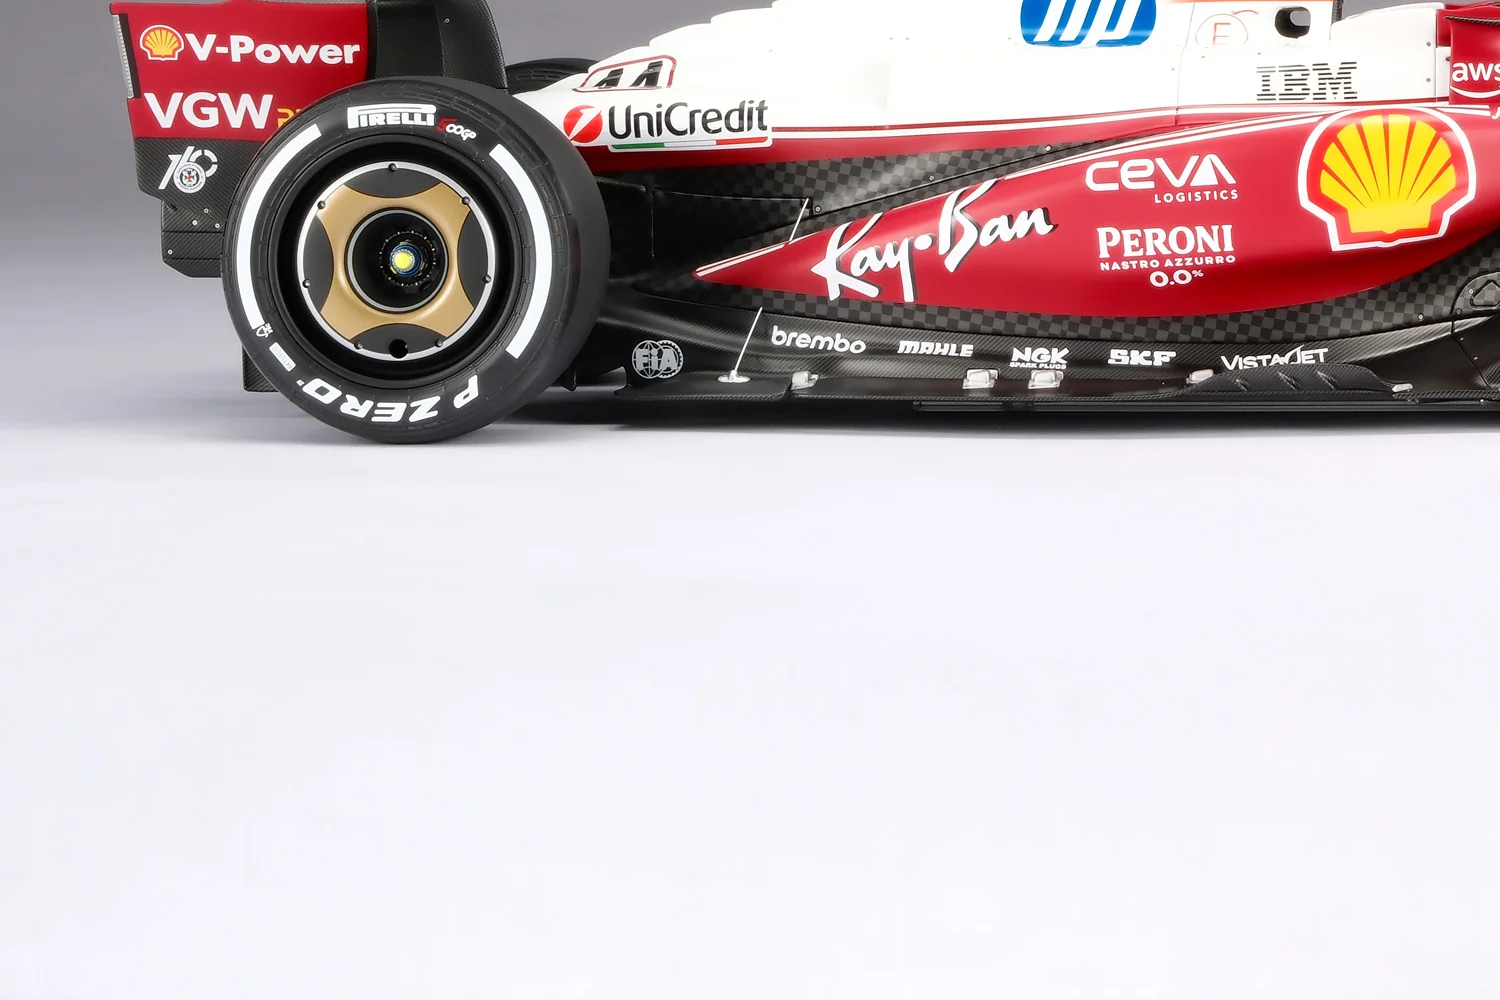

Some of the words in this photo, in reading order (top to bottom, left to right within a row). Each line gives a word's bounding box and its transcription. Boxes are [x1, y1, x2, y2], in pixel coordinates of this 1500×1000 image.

[185, 33, 361, 65] V-Power
[1256, 61, 1358, 101] IBM
[144, 92, 274, 129] VGW
[347, 102, 437, 130] PIRELLI
[608, 99, 769, 140] UniCredit
[1154, 189, 1239, 204] LOGISTICS
[1096, 224, 1235, 259] PERONI
[1100, 259, 1160, 271] NASTRO
[1164, 255, 1236, 267] AZZURRO
[1149, 269, 1204, 288] 0.0%
[771, 325, 867, 354] brembo
[897, 340, 974, 358] MAHLE
[1009, 361, 1038, 369] SPARK
[1011, 347, 1070, 364] NGK
[1108, 348, 1177, 366] SKF
[302, 377, 441, 423] ZERO
[453, 374, 479, 409] P
